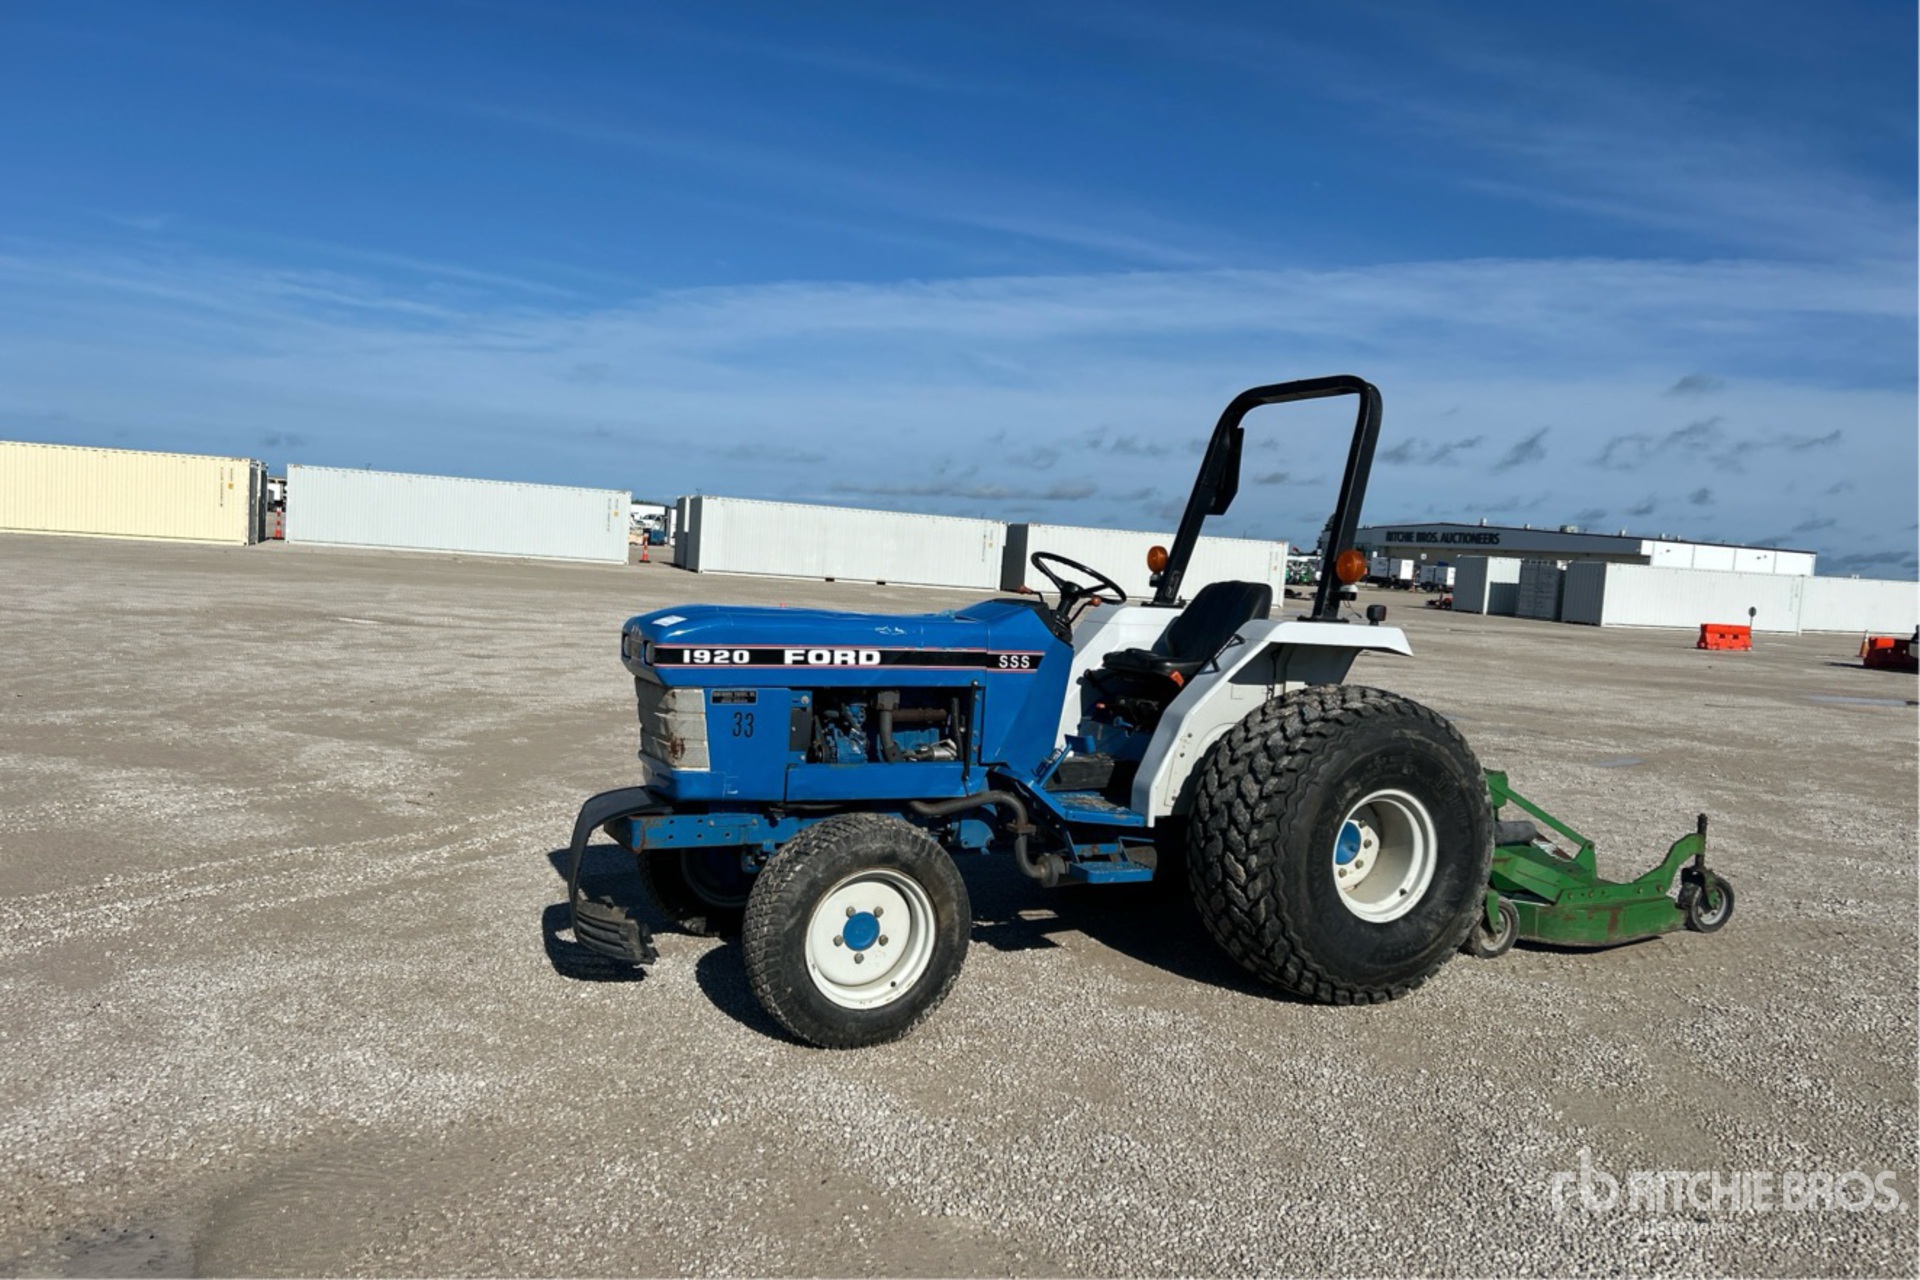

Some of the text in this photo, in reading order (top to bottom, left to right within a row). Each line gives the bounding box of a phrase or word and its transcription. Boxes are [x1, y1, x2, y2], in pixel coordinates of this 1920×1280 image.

[1385, 530, 1415, 543] RITCHIE
[1440, 531, 1501, 545] AUCTIONEERS
[683, 649, 881, 665] 1920 FORD
[999, 654, 1030, 669] SSS
[732, 711, 755, 738] 33
